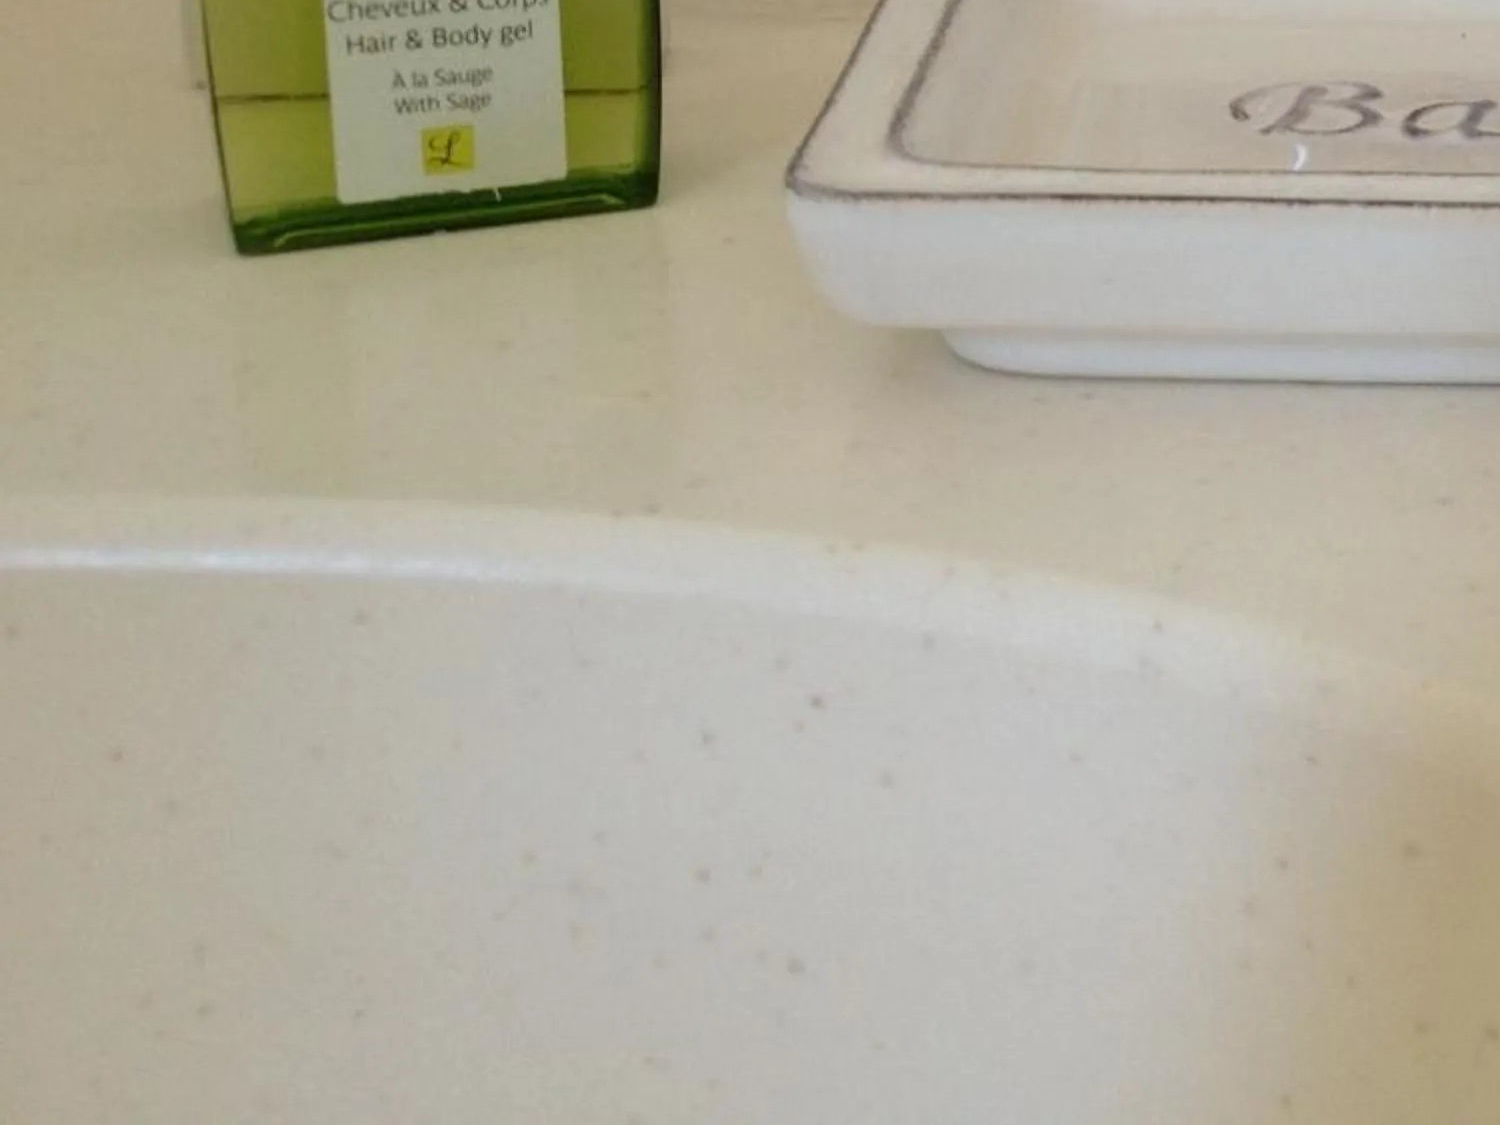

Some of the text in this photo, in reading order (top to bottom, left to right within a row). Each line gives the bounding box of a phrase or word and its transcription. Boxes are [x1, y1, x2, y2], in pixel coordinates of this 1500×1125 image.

[345, 19, 534, 55] Hair & Body gel
[411, 70, 429, 89] la
[434, 66, 494, 88] Sauge
[393, 91, 492, 115] With Sage
